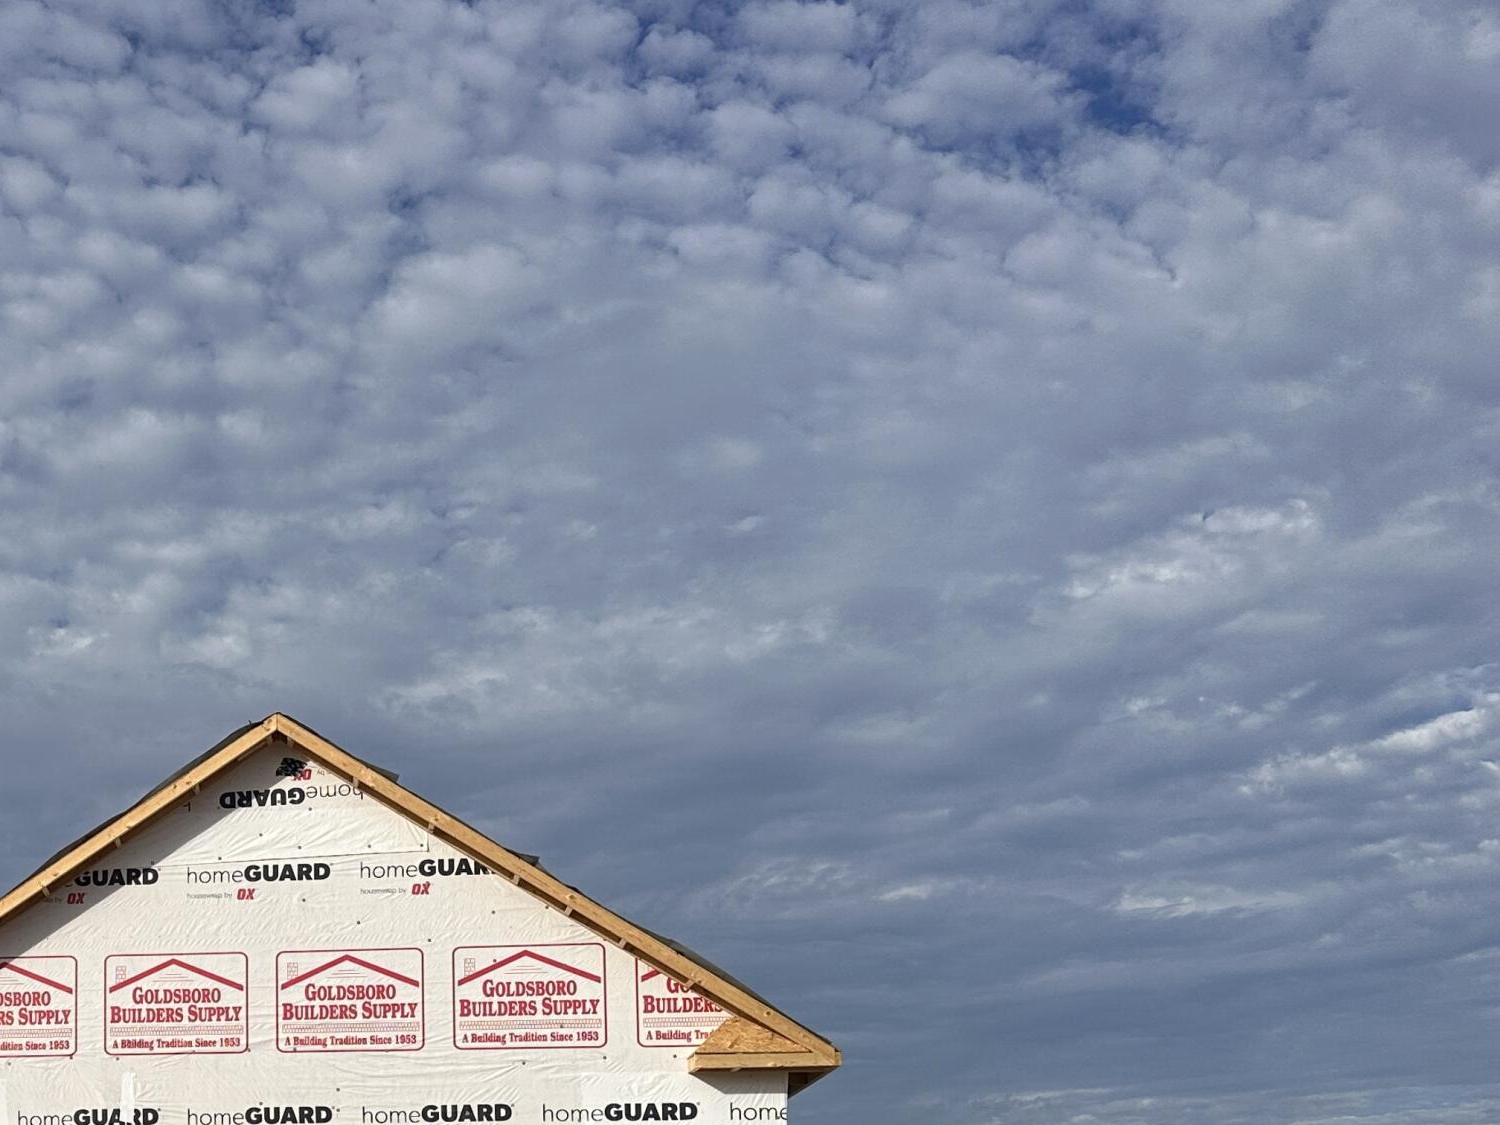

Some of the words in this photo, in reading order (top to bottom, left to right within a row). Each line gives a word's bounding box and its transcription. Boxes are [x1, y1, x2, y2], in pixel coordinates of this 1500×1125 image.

[187, 863, 331, 884] homeGUARD
[360, 858, 496, 879] homeGUAR
[237, 888, 256, 900] OX
[412, 883, 431, 895] OX
[67, 893, 85, 905] OX
[132, 986, 221, 1004] GOLDSBORO
[304, 983, 396, 1001] GOLDSBORO
[482, 979, 578, 998] GOLDSBORO
[110, 1006, 184, 1024] BUILDERS
[188, 1004, 242, 1022] SUPPLY
[282, 1003, 358, 1020] BUILDERS
[362, 1002, 418, 1020] SUPPLY
[459, 999, 538, 1018] BUILDERS
[542, 997, 600, 1016] SUPPLY
[18, 1008, 71, 1026] SUPPLY
[112, 1040, 118, 1049] A
[120, 1039, 154, 1050] Building
[157, 1038, 193, 1048] Tradition
[194, 1038, 217, 1048] Since
[220, 1038, 241, 1047] 1953
[285, 1036, 291, 1046] A
[293, 1036, 328, 1048] Building
[330, 1036, 368, 1046] Tradition
[370, 1035, 392, 1045] Since
[394, 1034, 417, 1044] 1953
[462, 1034, 468, 1043] A
[470, 1033, 506, 1045] Building
[508, 1032, 548, 1042] Tradition
[550, 1032, 574, 1042] Since
[576, 1031, 599, 1041] 1953
[646, 1031, 653, 1040] A
[656, 1030, 692, 1042] Building
[26, 1041, 47, 1051] Since
[49, 1040, 70, 1050] 1953
[188, 1106, 332, 1125] homeGUARD
[362, 1104, 512, 1124] homeGUARD
[543, 1102, 698, 1122] homeGUARD
